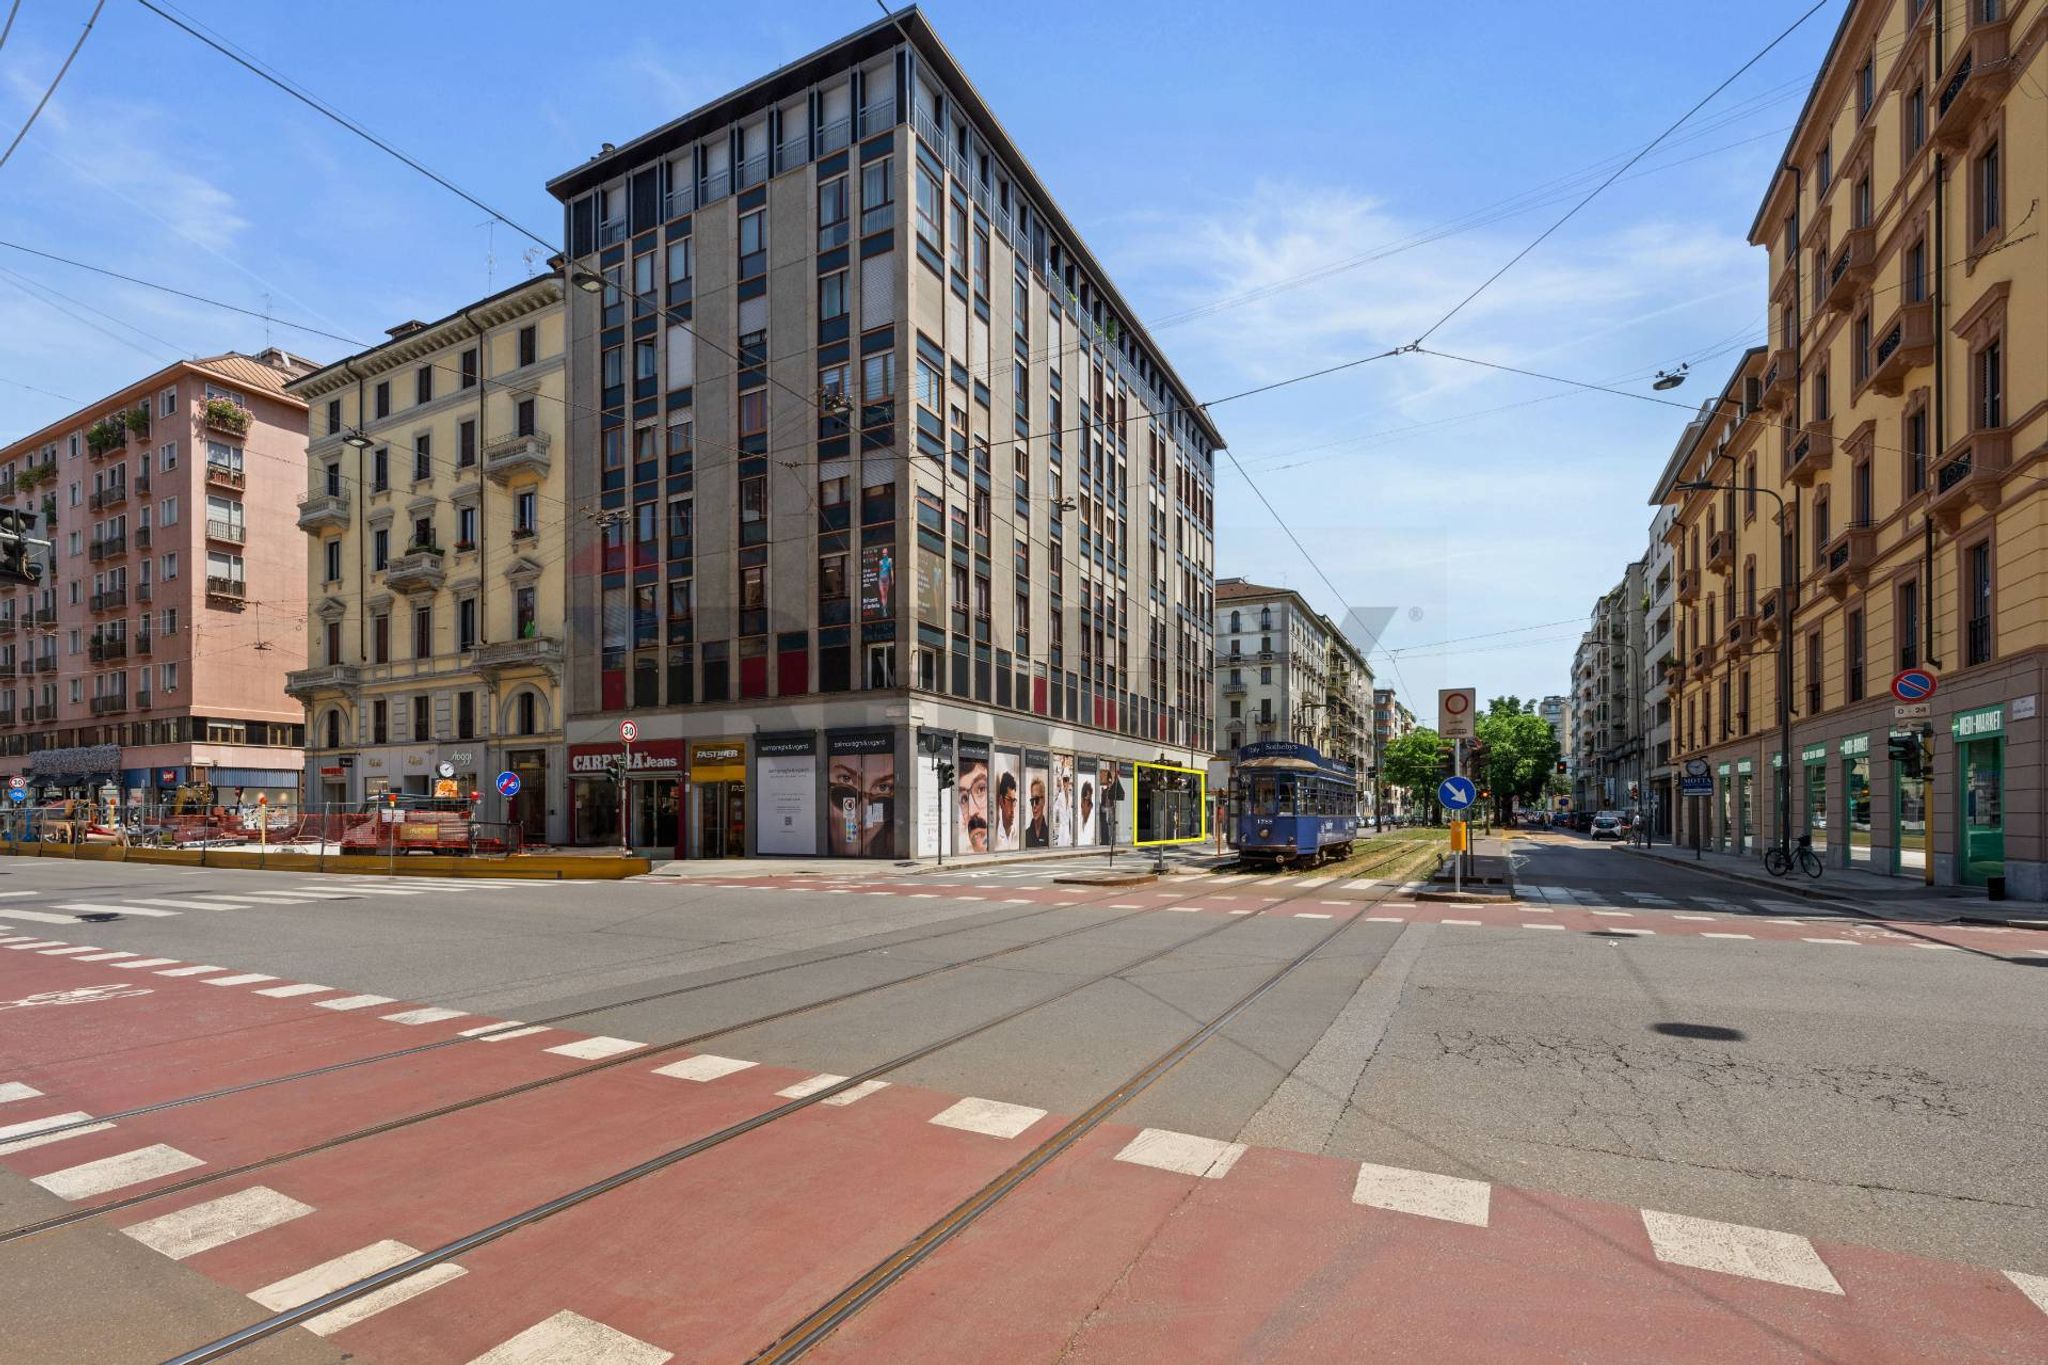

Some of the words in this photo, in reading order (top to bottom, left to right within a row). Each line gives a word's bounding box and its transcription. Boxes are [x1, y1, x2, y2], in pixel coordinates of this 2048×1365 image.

[1959, 710, 2001, 736] MEDI-MARKET
[623, 725, 634, 737] 30
[645, 756, 678, 768] Jeans
